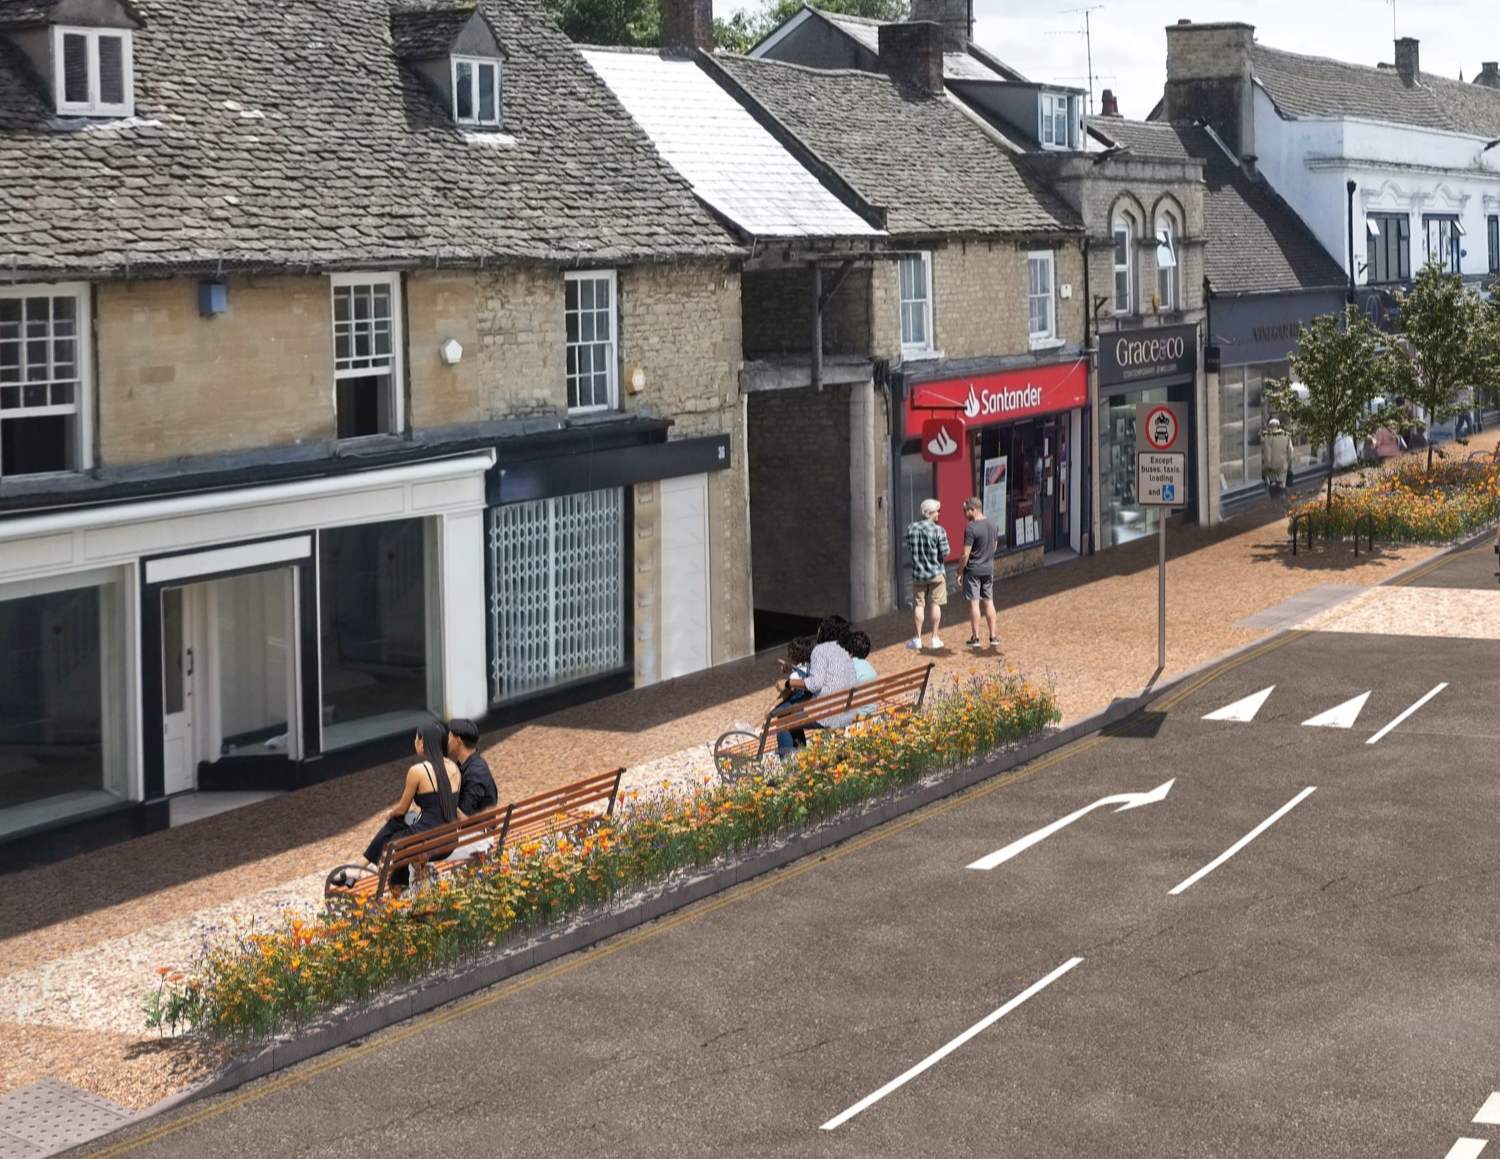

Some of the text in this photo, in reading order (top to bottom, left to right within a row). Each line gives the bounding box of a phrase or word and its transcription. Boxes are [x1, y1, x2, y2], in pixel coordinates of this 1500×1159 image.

[980, 382, 1042, 415] Santander
[1150, 456, 1173, 465] Except
[1149, 474, 1174, 483] loading
[1148, 488, 1160, 496] and
